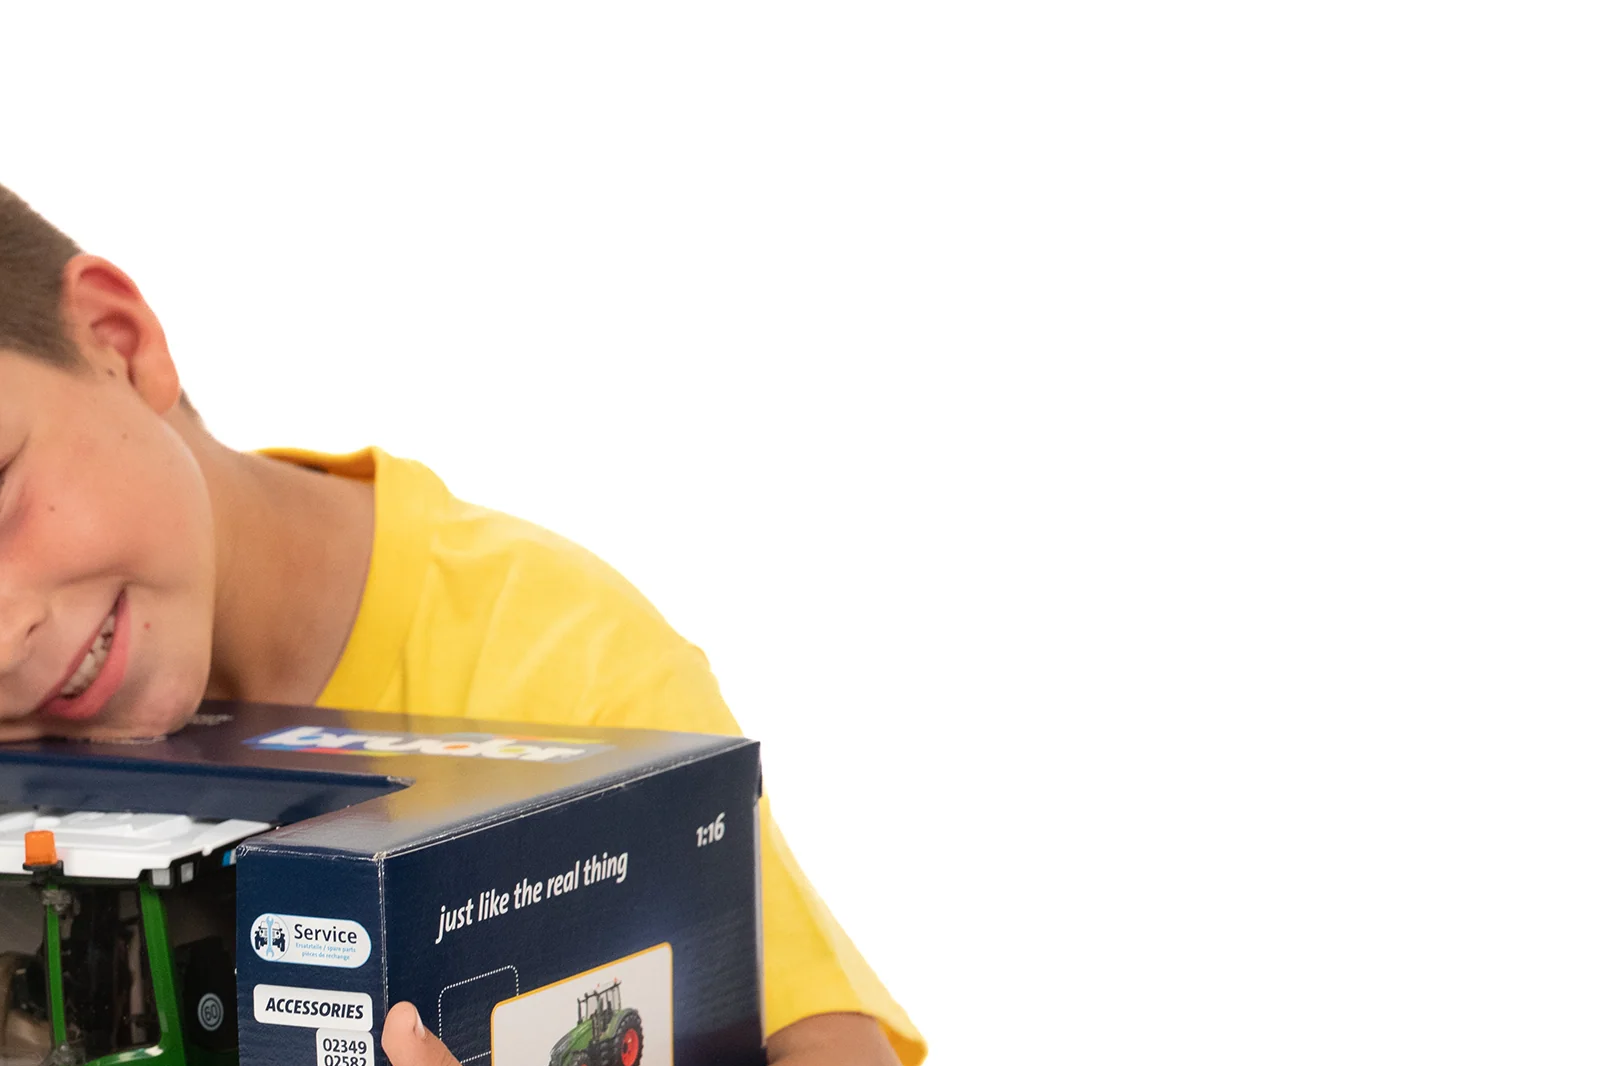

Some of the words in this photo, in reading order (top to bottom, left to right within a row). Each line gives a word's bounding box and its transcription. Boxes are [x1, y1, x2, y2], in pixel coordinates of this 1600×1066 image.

[259, 726, 587, 762] bruder
[695, 812, 726, 847] 1:16
[434, 897, 474, 944] just
[477, 888, 510, 922] like
[513, 878, 543, 910] the
[546, 860, 581, 899] real
[583, 851, 629, 887] thing
[294, 923, 357, 944] Service
[265, 997, 364, 1020] ACCESSORIES
[322, 1038, 367, 1054] 02349
